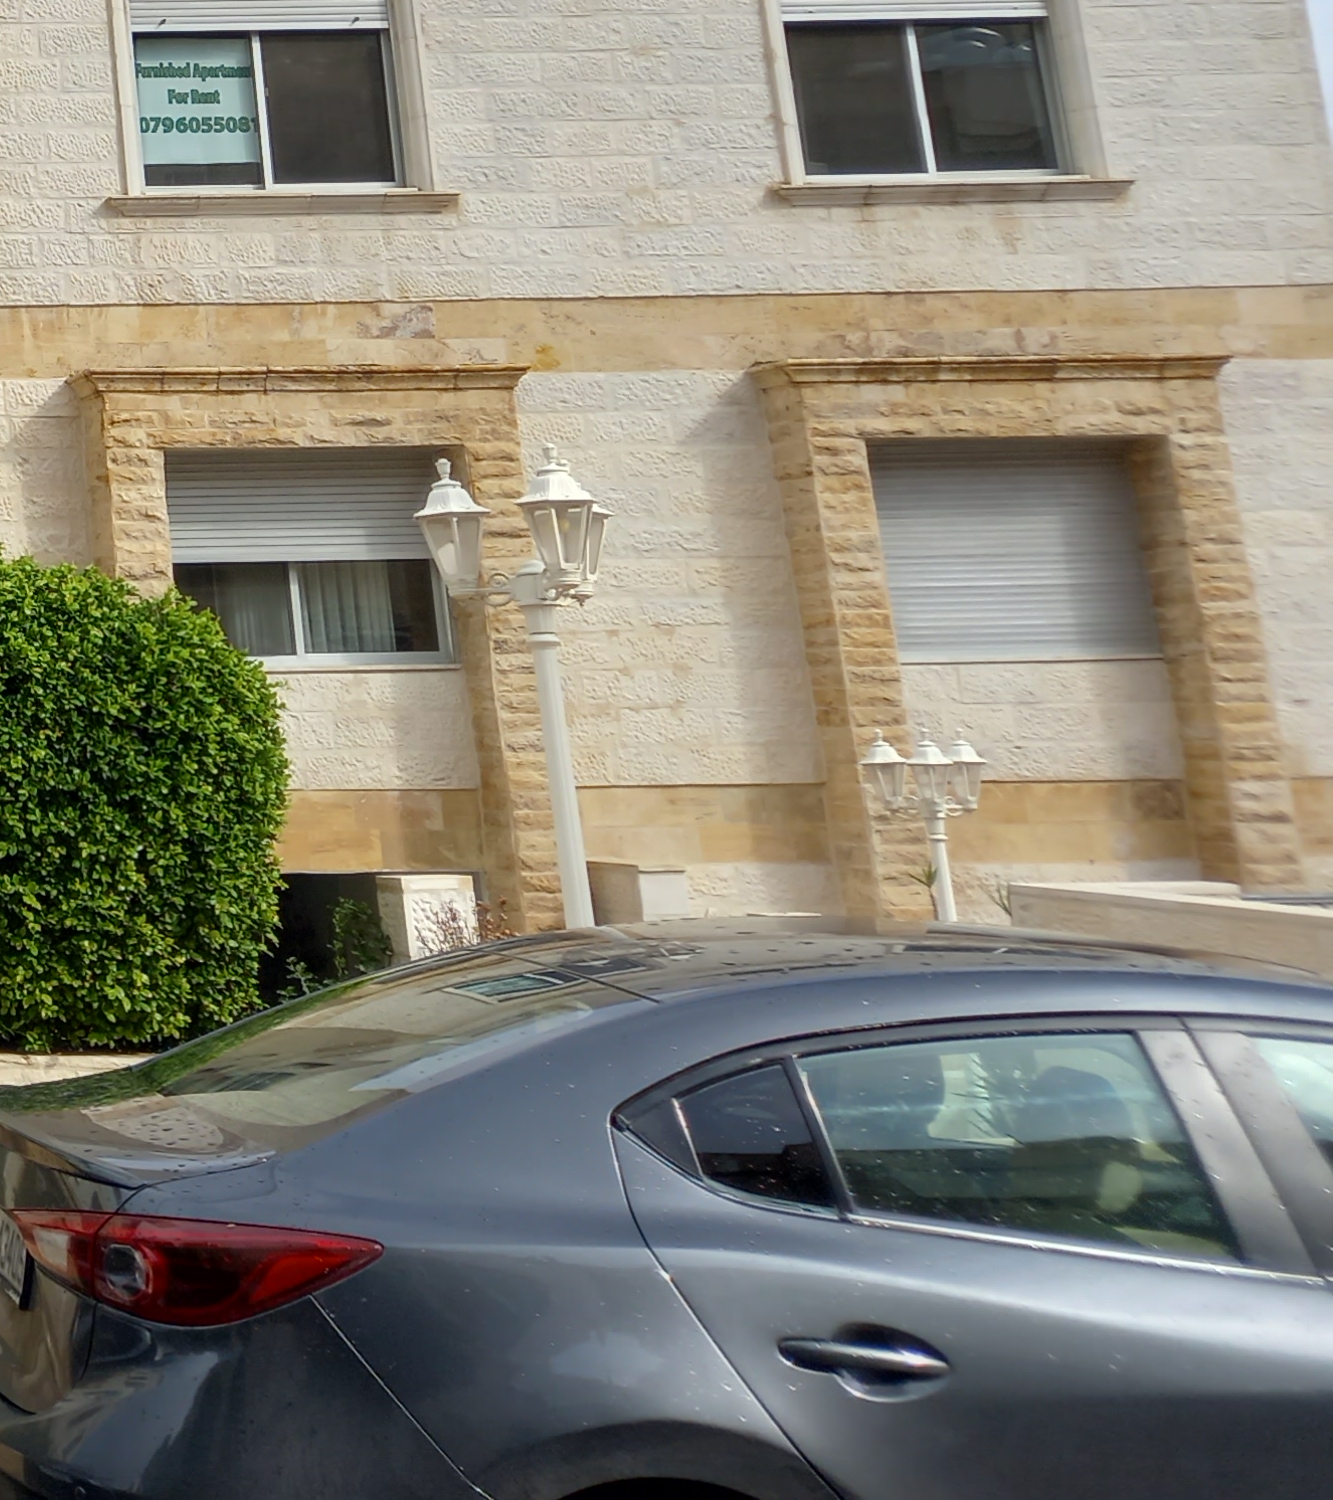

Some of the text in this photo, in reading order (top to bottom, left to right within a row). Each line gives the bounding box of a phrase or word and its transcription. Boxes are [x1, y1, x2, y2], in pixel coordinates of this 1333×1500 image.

[135, 62, 252, 82] Furnished Apartmen
[167, 89, 220, 104] For Rent
